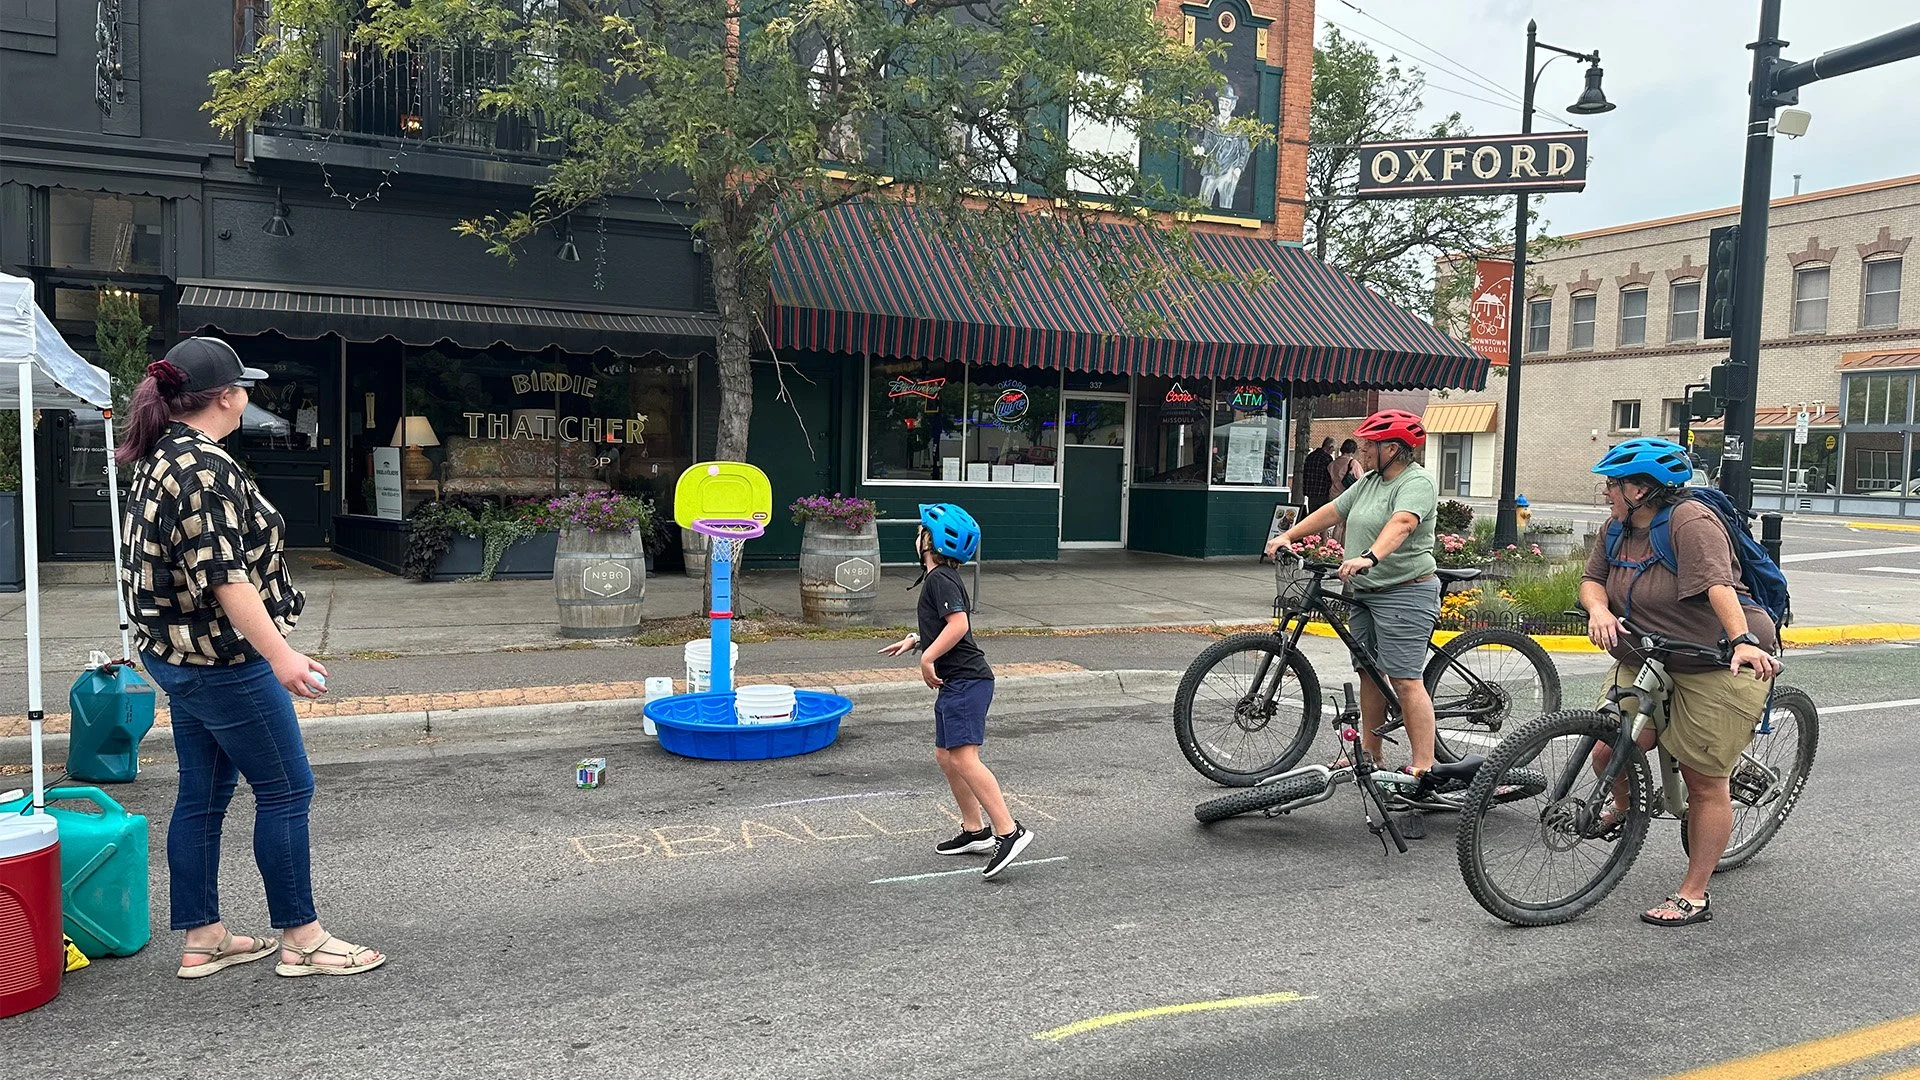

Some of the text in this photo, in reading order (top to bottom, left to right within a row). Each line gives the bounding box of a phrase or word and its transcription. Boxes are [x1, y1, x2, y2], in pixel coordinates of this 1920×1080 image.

[1371, 142, 1575, 184] OXFORD
[512, 370, 598, 398] BIRDIE
[997, 379, 1027, 391] OXFORD
[1089, 381, 1103, 389] 337
[1165, 390, 1193, 402] Coors
[1232, 393, 1263, 406] ATM
[463, 412, 646, 445] THATCHER
[1162, 416, 1195, 424] MISSOULA
[500, 456, 611, 469] WORKSOP
[1633, 763, 1647, 813] MAXXIS
[1778, 776, 1804, 821] MAXXIS
[568, 810, 936, 863] BBALL
